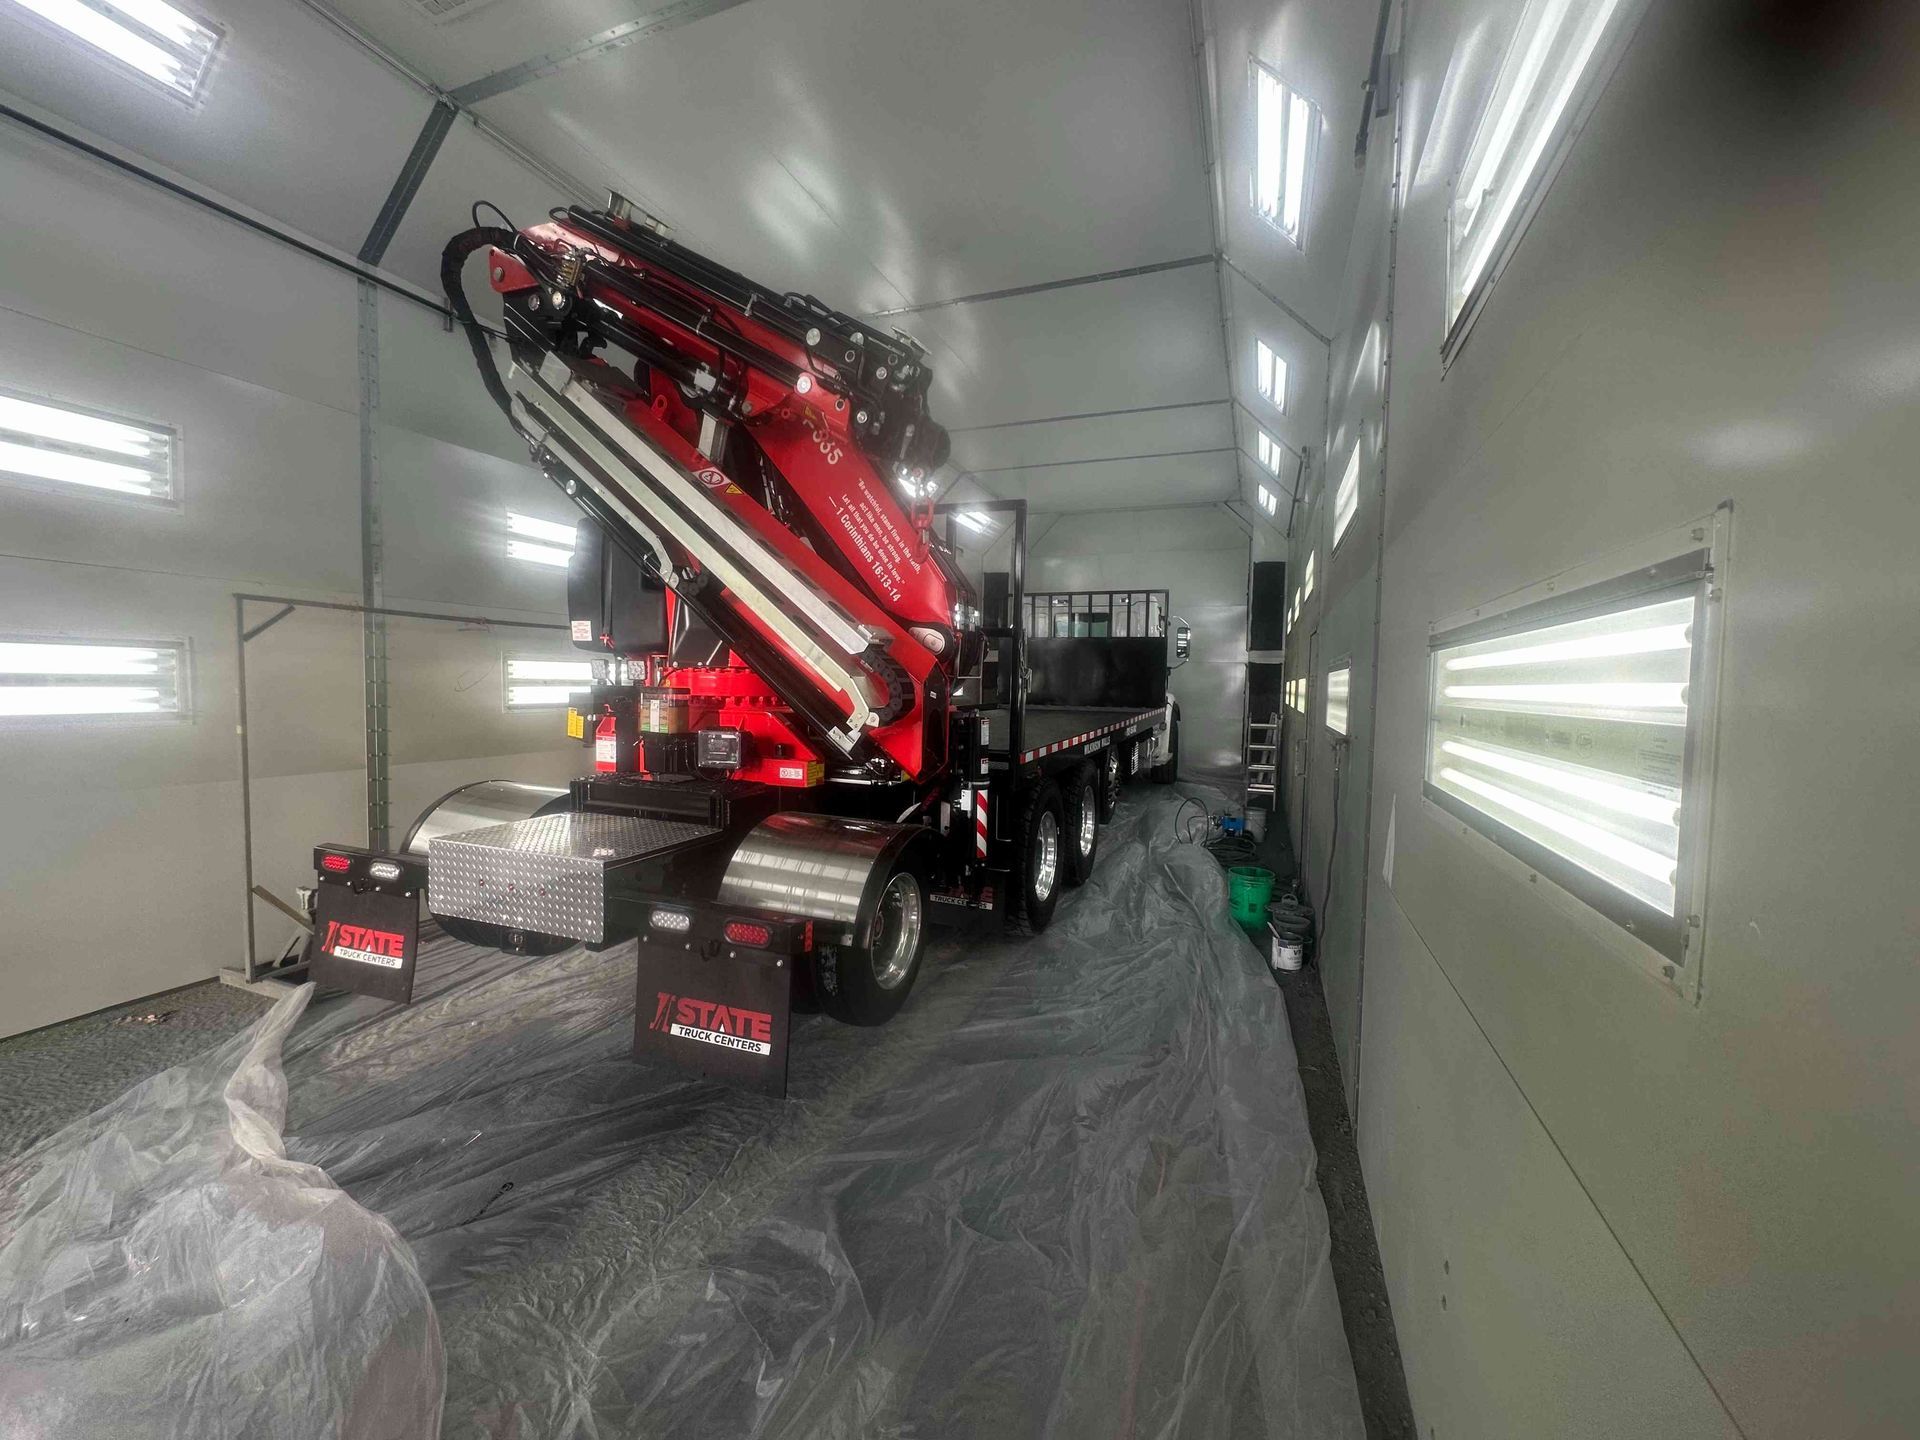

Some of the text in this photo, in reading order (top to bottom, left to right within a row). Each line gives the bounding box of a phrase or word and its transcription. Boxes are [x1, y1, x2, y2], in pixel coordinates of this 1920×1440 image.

[840, 493, 851, 506] Let
[846, 503, 856, 513] all
[851, 510, 864, 525] that
[858, 522, 870, 535] you
[866, 532, 875, 542] do
[871, 539, 880, 550] be
[876, 547, 889, 564] done
[885, 561, 894, 570] in
[858, 501, 869, 513] act
[864, 510, 875, 524] like
[871, 521, 884, 537] men,
[880, 534, 890, 545] be
[862, 488, 883, 515] watchful,
[879, 513, 894, 531] stand
[889, 528, 901, 542] firm
[897, 540, 905, 549] in
[901, 546, 912, 559] the
[834, 506, 844, 516] 1
[839, 513, 875, 563] Corinthians
[870, 559, 902, 602] 16:13-14
[934, 896, 955, 904] TRUCK
[340, 948, 396, 967] TRUCK CENTERS
[678, 1026, 761, 1052] TRUCK CENTERS
